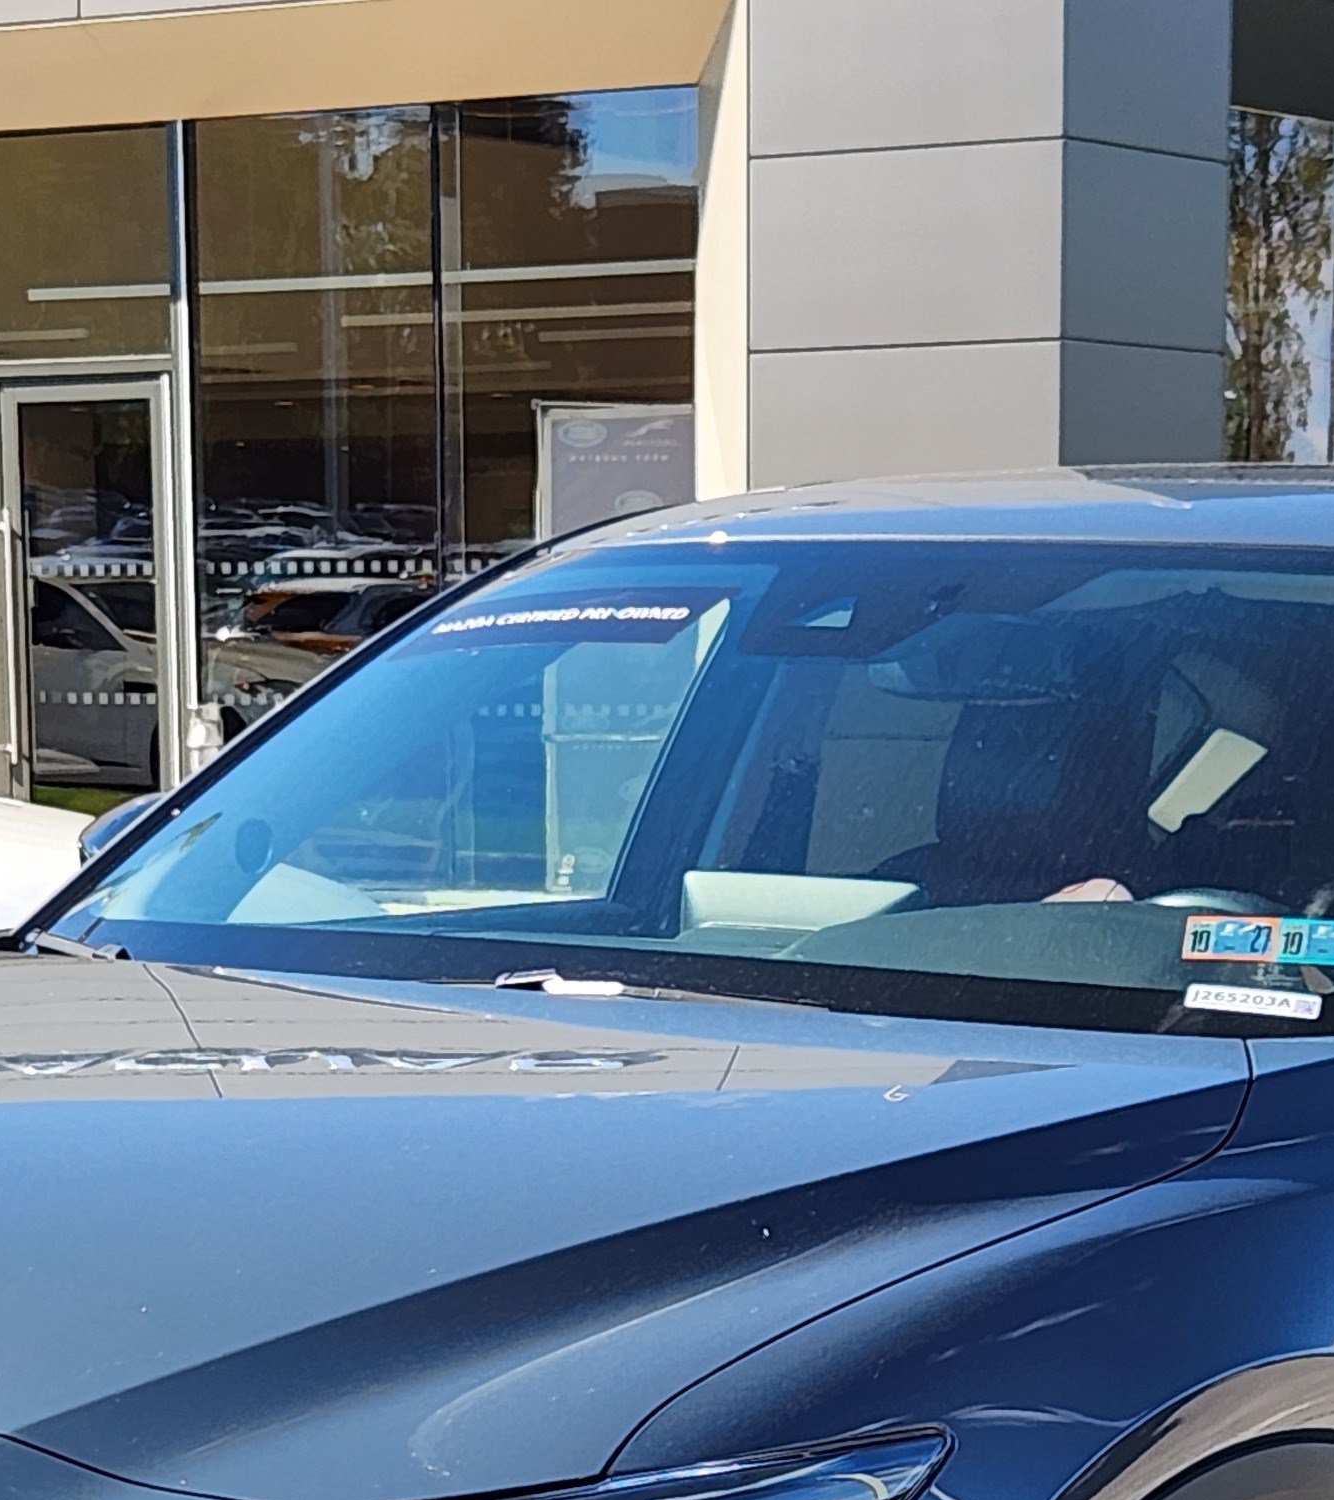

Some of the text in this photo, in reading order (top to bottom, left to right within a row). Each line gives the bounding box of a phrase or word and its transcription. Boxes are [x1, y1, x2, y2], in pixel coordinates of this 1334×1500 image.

[1190, 925, 1272, 955] 10 27
[1282, 932, 1303, 955] 10
